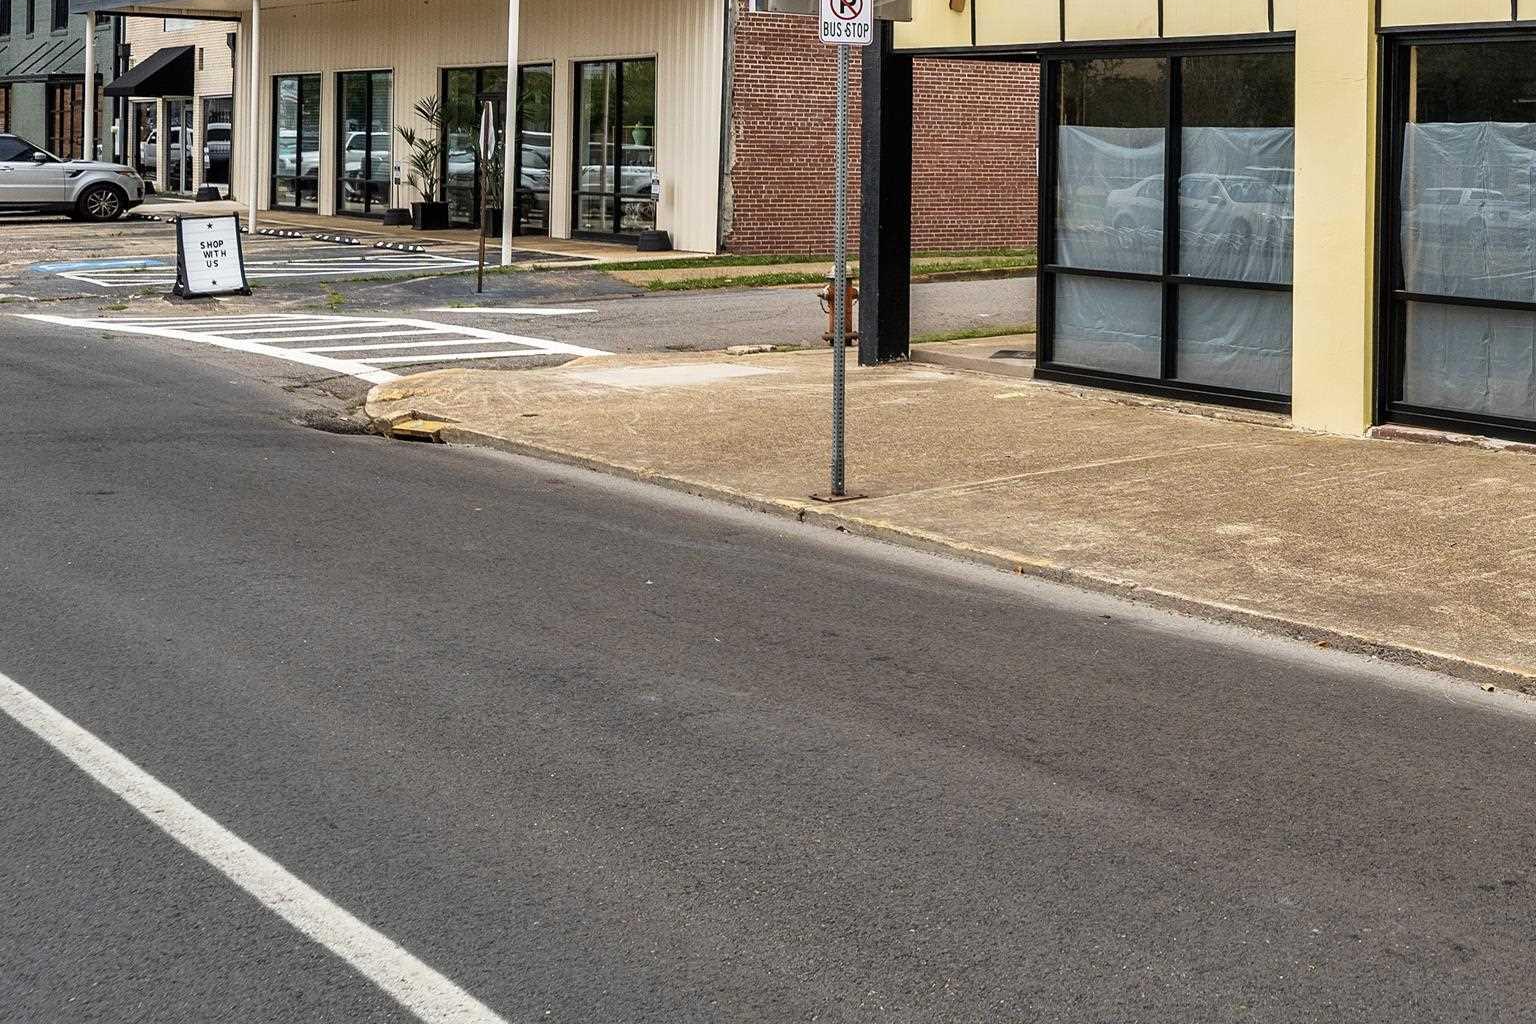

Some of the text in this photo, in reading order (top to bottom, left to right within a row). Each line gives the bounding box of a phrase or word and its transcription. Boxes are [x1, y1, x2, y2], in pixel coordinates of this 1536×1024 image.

[823, 21, 869, 38] BUS STOP
[200, 240, 224, 249] SHOP
[203, 250, 227, 259] WITH
[206, 260, 219, 268] US
